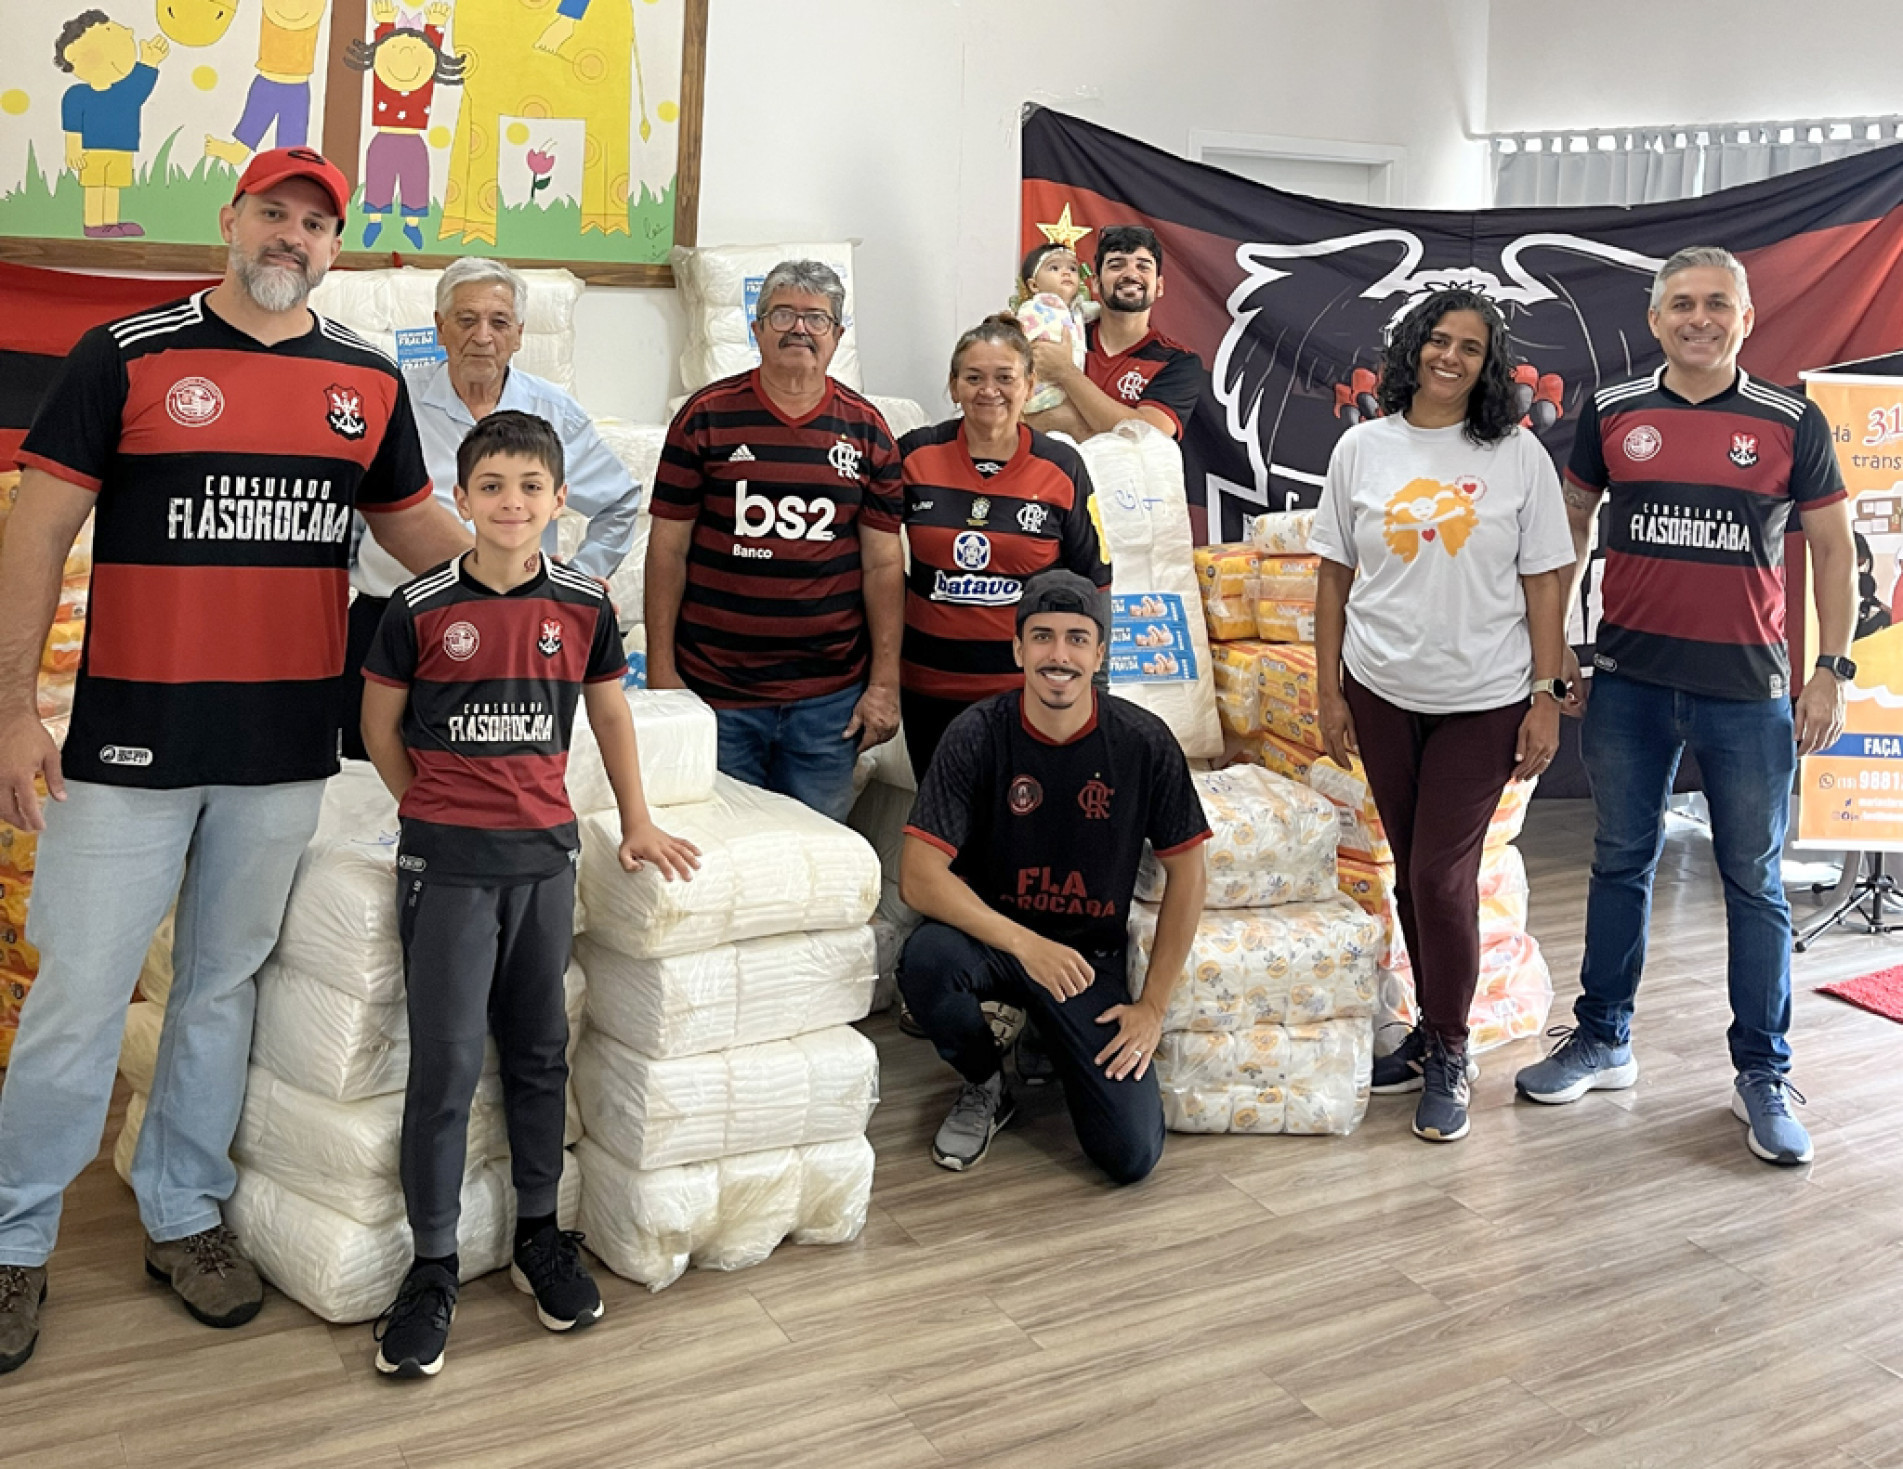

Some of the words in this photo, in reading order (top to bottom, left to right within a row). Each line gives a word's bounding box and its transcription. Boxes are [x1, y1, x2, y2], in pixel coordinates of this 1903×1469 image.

[1864, 407, 1903, 444] 31
[205, 475, 331, 500] CONSULADO
[168, 497, 349, 543] FLASOROCABA
[734, 479, 836, 541] bs2
[1630, 514, 1750, 552] FLASOROCABA
[733, 543, 773, 558] Banco
[934, 571, 1021, 596] batavo
[1863, 737, 1902, 758] FAÇA
[1860, 771, 1903, 790] 9881
[1017, 866, 1087, 898] FLA
